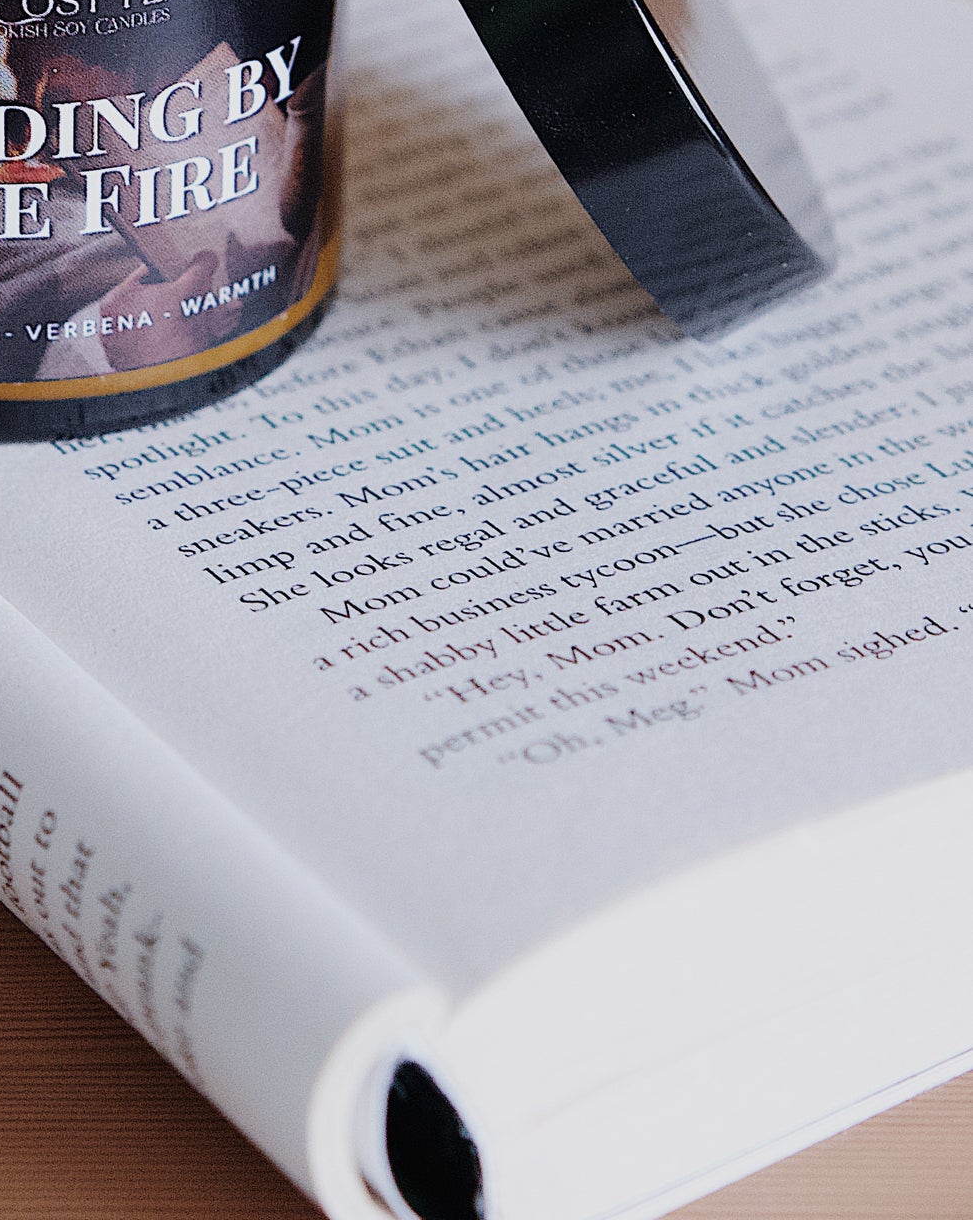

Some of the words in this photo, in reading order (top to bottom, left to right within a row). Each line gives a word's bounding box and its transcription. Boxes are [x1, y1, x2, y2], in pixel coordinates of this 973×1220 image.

[53, 21, 89, 37] SOY
[95, 7, 172, 35] CANDLES
[223, 35, 303, 126] BY
[78, 136, 260, 236] FIRE
[25, 309, 155, 344] VERBENA
[179, 264, 278, 319] WARMTH
[83, 429, 247, 481] spotlight.
[248, 411, 305, 430] To
[312, 389, 377, 415] this
[114, 446, 302, 506] semblance.
[306, 413, 405, 450] Mom
[409, 400, 442, 419] is
[448, 382, 509, 407] one
[146, 517, 170, 531] a
[173, 458, 369, 523] three-piece
[374, 437, 440, 465] suit
[443, 412, 507, 444] and
[177, 506, 333, 558] sneakers.
[335, 465, 459, 509] Mom's
[458, 442, 532, 473] hair
[534, 411, 641, 448] hangs
[641, 398, 684, 418] in
[202, 550, 296, 586] limp
[305, 522, 375, 555] and
[378, 505, 466, 533] fine,
[471, 460, 588, 507] almost
[591, 431, 681, 467] silver
[684, 416, 716, 439] if
[717, 412, 755, 429] it
[239, 582, 311, 613] She
[309, 550, 415, 589] looks
[418, 519, 508, 558] regal
[512, 497, 578, 530] and
[583, 454, 720, 512] graceful
[724, 434, 788, 465] and
[318, 585, 426, 625] Mom
[430, 545, 574, 591] could've
[577, 491, 714, 546] married
[717, 462, 834, 504] anyone
[834, 450, 875, 469] in
[878, 433, 933, 458] the
[313, 656, 336, 671] a
[340, 627, 412, 660] rich
[409, 581, 557, 633] business
[776, 498, 832, 523] she
[837, 471, 927, 506] chose
[348, 684, 373, 702] a
[377, 638, 499, 688] shabby
[500, 610, 591, 645] little
[593, 581, 685, 617] farm
[688, 559, 751, 587] out
[747, 548, 795, 568] in
[795, 531, 855, 554] the
[858, 503, 961, 537] sticks.
[544, 631, 665, 670] Mom.
[666, 589, 779, 631] Don't
[779, 557, 903, 598] forget,
[902, 525, 973, 566] you
[725, 656, 833, 696] Mom
[836, 616, 960, 664] sighed.
[419, 706, 547, 770] permit
[549, 681, 620, 712] this
[33, 809, 57, 850] to
